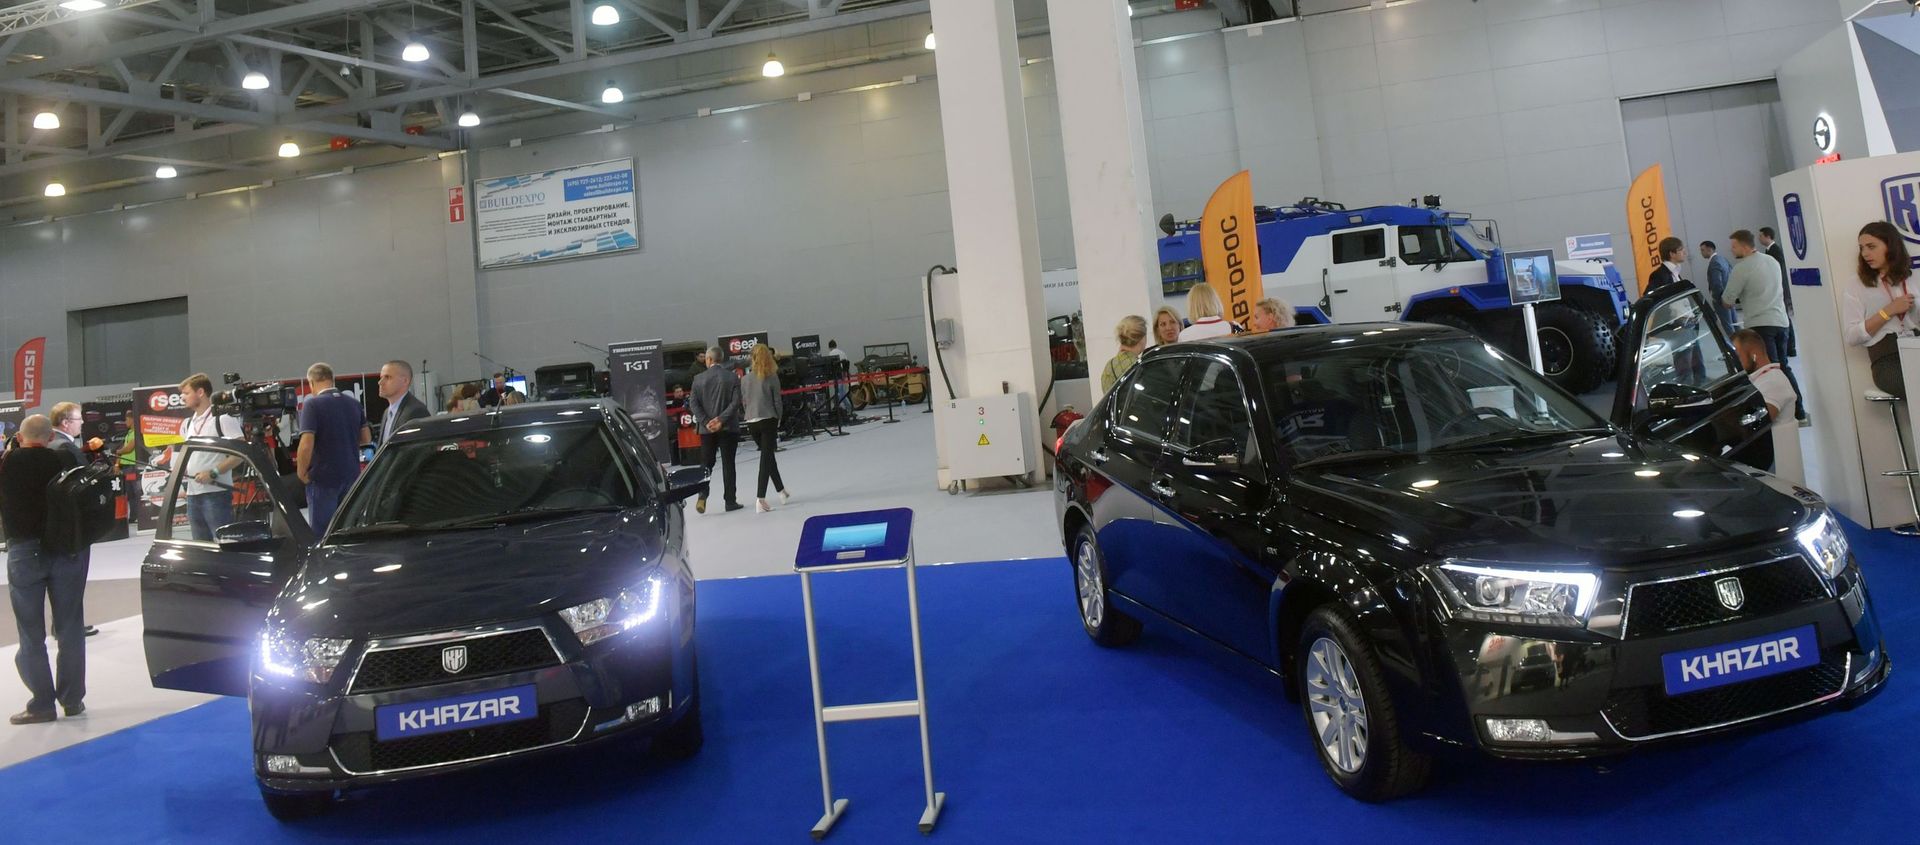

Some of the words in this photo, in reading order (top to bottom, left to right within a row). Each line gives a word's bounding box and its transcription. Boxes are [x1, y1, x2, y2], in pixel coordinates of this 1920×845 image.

[487, 192, 546, 209] BUILDEXPO
[547, 211, 572, 220] ДИЗАЙН,
[574, 202, 630, 214] ПРОЕКТИРОВАНИЕ,
[547, 218, 572, 227] МОНТАЖ
[574, 212, 617, 223] СТАНДАРТНЫХ
[554, 224, 602, 235] ЭКСКЛЮЗИВНЫХ
[1641, 195, 1661, 268] ВТОРОС
[1221, 215, 1252, 332] АВТОРОС
[729, 336, 758, 351] rseat
[24, 350, 36, 402] ISUZU
[151, 393, 187, 408] rsea
[978, 407, 985, 415] 3
[1681, 636, 1801, 682] KHAZAR
[399, 695, 521, 731] KHAZAR
